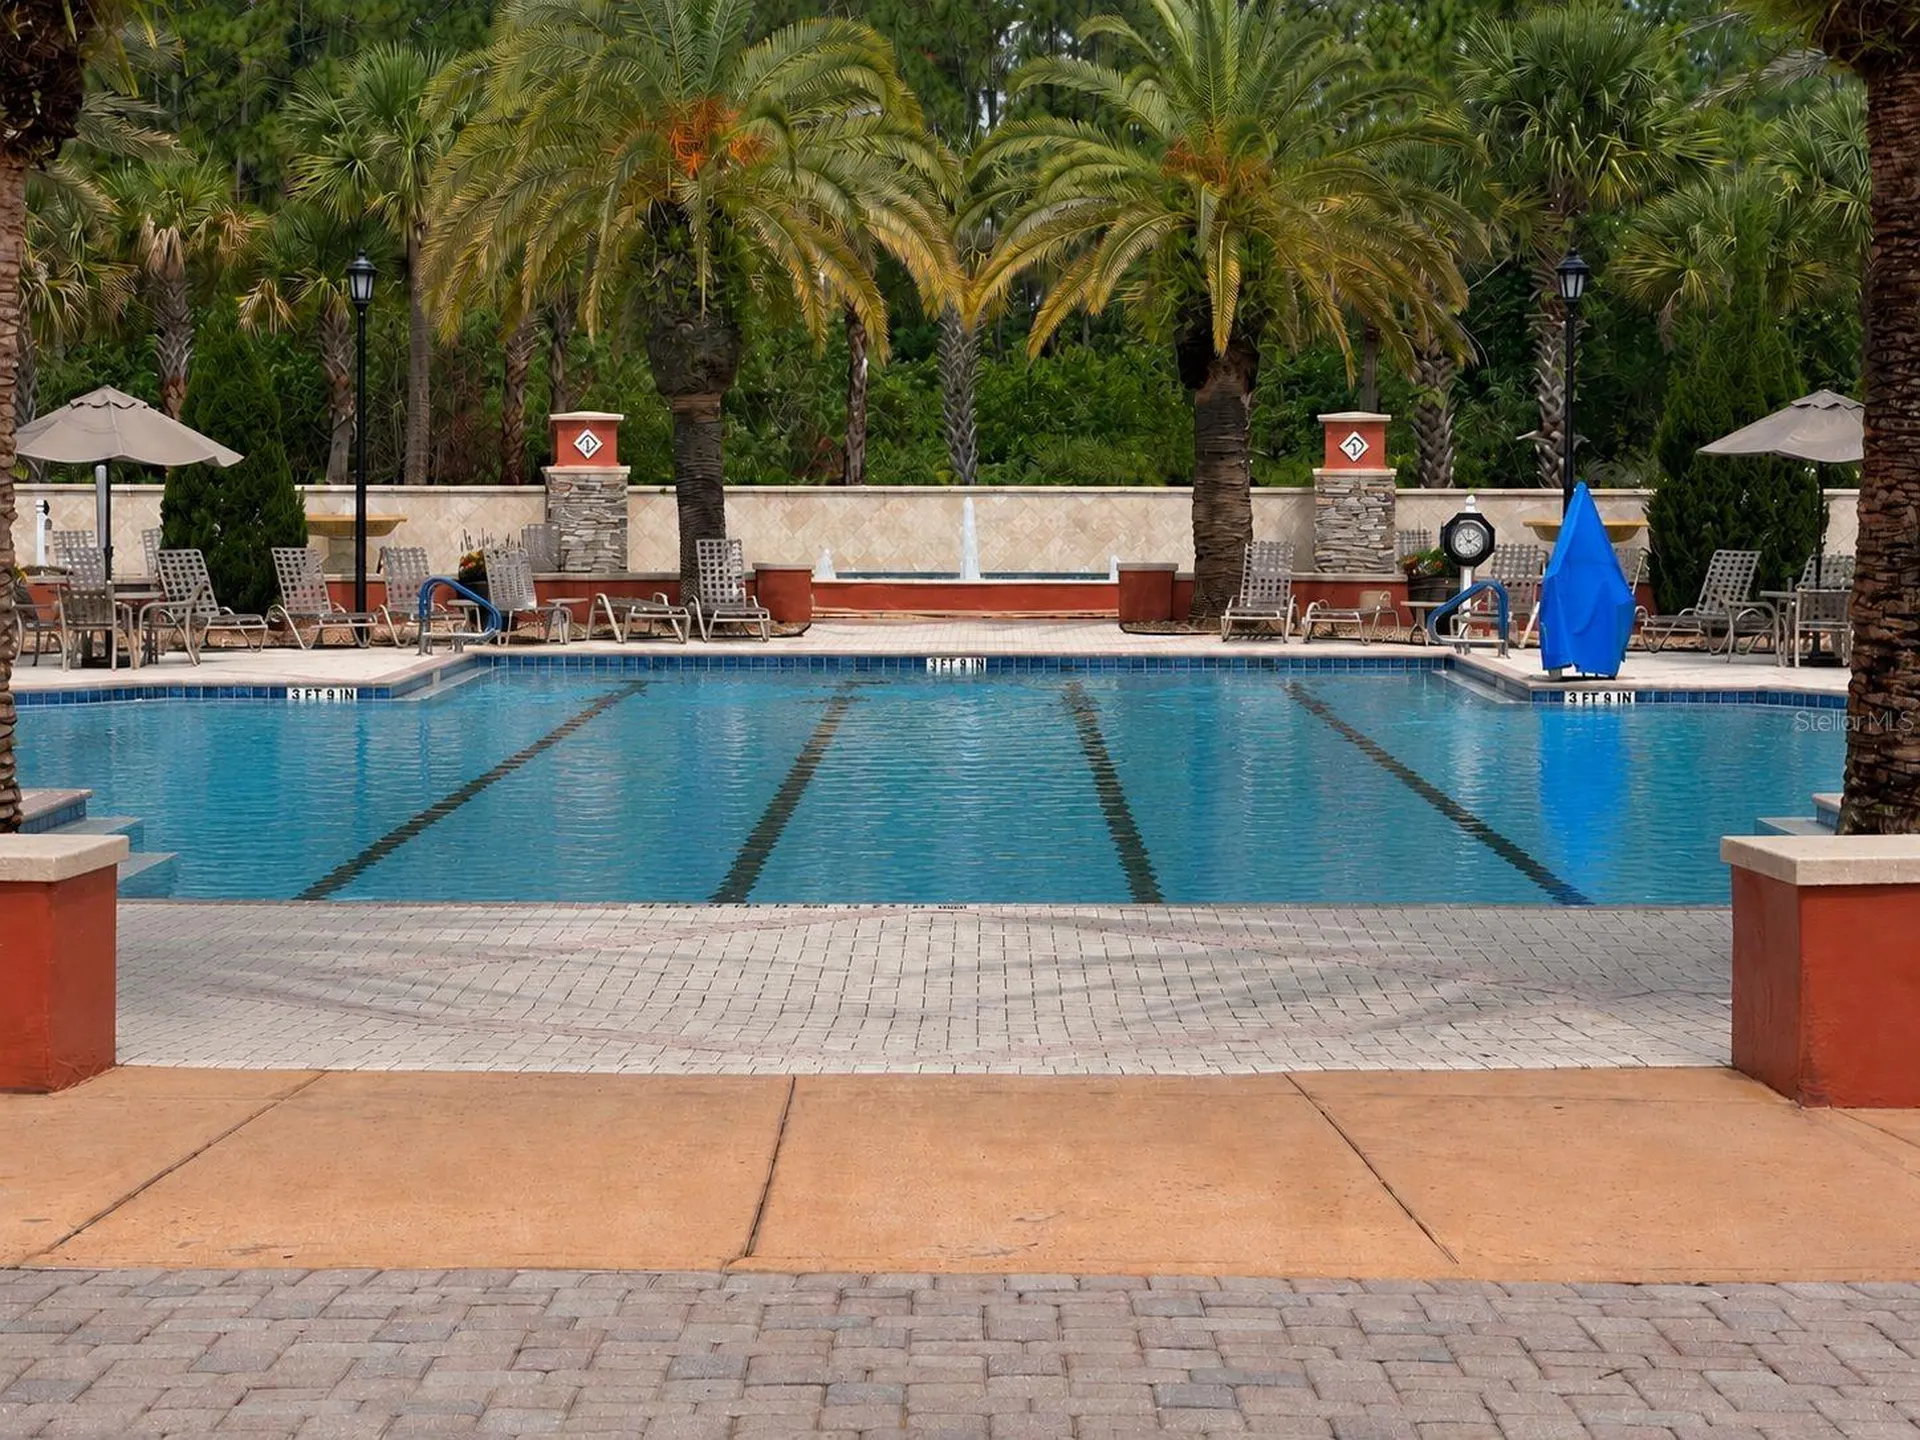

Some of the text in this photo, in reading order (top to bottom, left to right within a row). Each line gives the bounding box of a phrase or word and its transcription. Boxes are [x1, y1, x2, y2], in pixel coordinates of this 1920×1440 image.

[940, 658, 955, 669] FT
[292, 688, 354, 700] 3 FT 9 IN
[1569, 692, 1577, 703] 3
[1582, 692, 1599, 703] FT
[1617, 692, 1631, 703] IN
